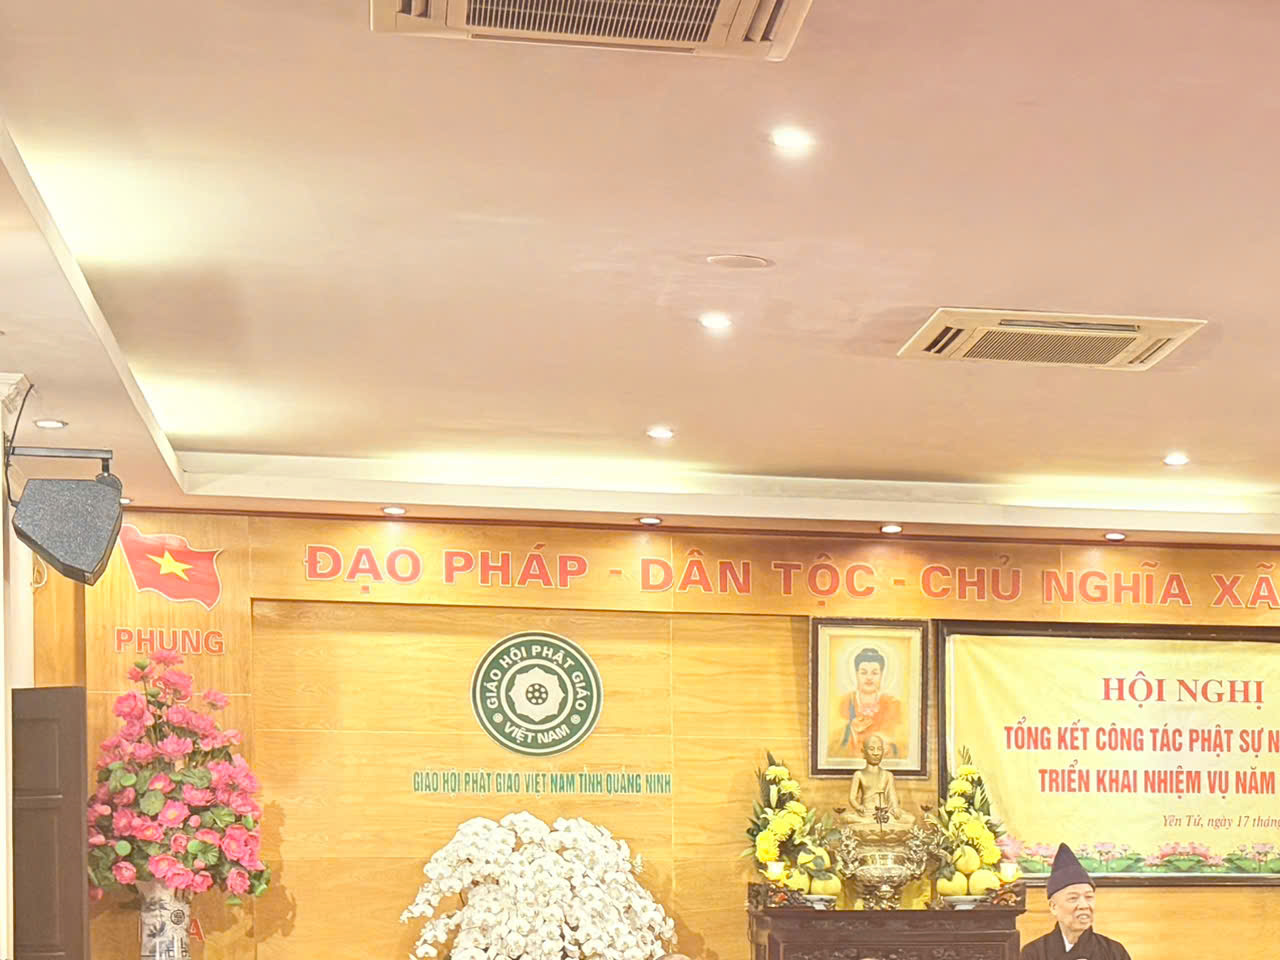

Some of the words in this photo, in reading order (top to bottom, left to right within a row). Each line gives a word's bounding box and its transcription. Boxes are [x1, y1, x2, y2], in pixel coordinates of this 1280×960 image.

[304, 544, 423, 594] ĐẠO
[442, 543, 588, 589] PHÁP
[640, 548, 752, 595] DÂN
[772, 552, 876, 606] TỘC
[920, 554, 1023, 601] CHỦ
[1043, 560, 1192, 607] NGHĨA
[483, 668, 502, 709] GIÁO
[498, 646, 527, 668] HỘI
[531, 645, 575, 669] PHẬT
[571, 671, 591, 711] GIÁO
[1102, 670, 1167, 708] HỘI
[1176, 678, 1265, 710] NGHỊ
[504, 721, 536, 744] VIỆT
[536, 723, 571, 744] NAM
[1004, 716, 1051, 750] TỔNG
[1057, 719, 1090, 750] KẾT
[1095, 722, 1144, 751] CÔNG
[1150, 722, 1183, 752] TÁC
[1189, 724, 1233, 758] PHẬT
[1239, 727, 1264, 758] SỰ
[550, 773, 576, 794] NAM
[645, 773, 672, 794] NINH
[1038, 759, 1090, 793] TRIỂN
[1096, 770, 1138, 793] KHAI
[1144, 765, 1201, 799] NHIỆM
[1207, 771, 1229, 800] VỤ
[1235, 766, 1276, 795] NĂM
[1163, 814, 1182, 828] Yên
[1207, 815, 1233, 831] ngày
[1237, 815, 1250, 828] 17
